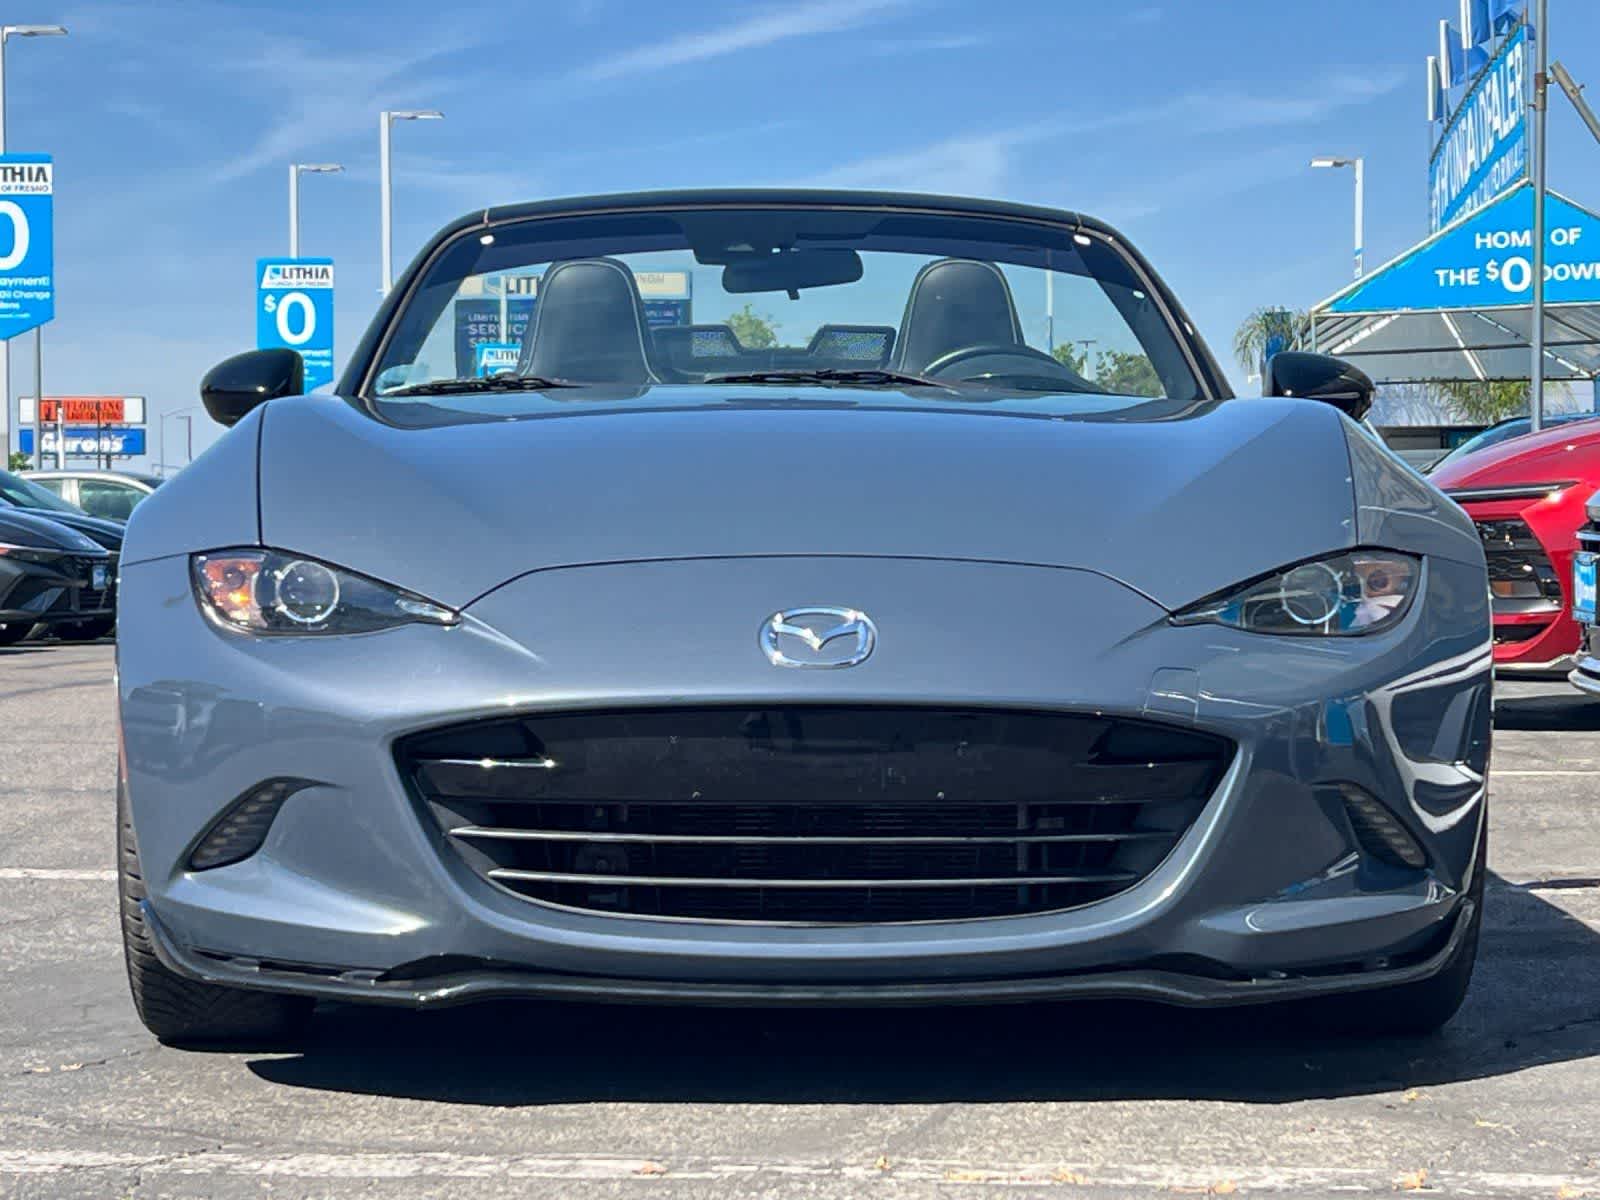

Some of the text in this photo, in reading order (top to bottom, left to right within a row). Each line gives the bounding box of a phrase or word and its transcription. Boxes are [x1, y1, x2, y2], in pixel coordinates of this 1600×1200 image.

[1480, 41, 1524, 162] DEALER
[1475, 228, 1582, 250] HOM OF
[282, 267, 330, 280] LITHIA
[1434, 267, 1481, 287] THE
[1486, 256, 1532, 293] $0
[264, 291, 317, 345] $0
